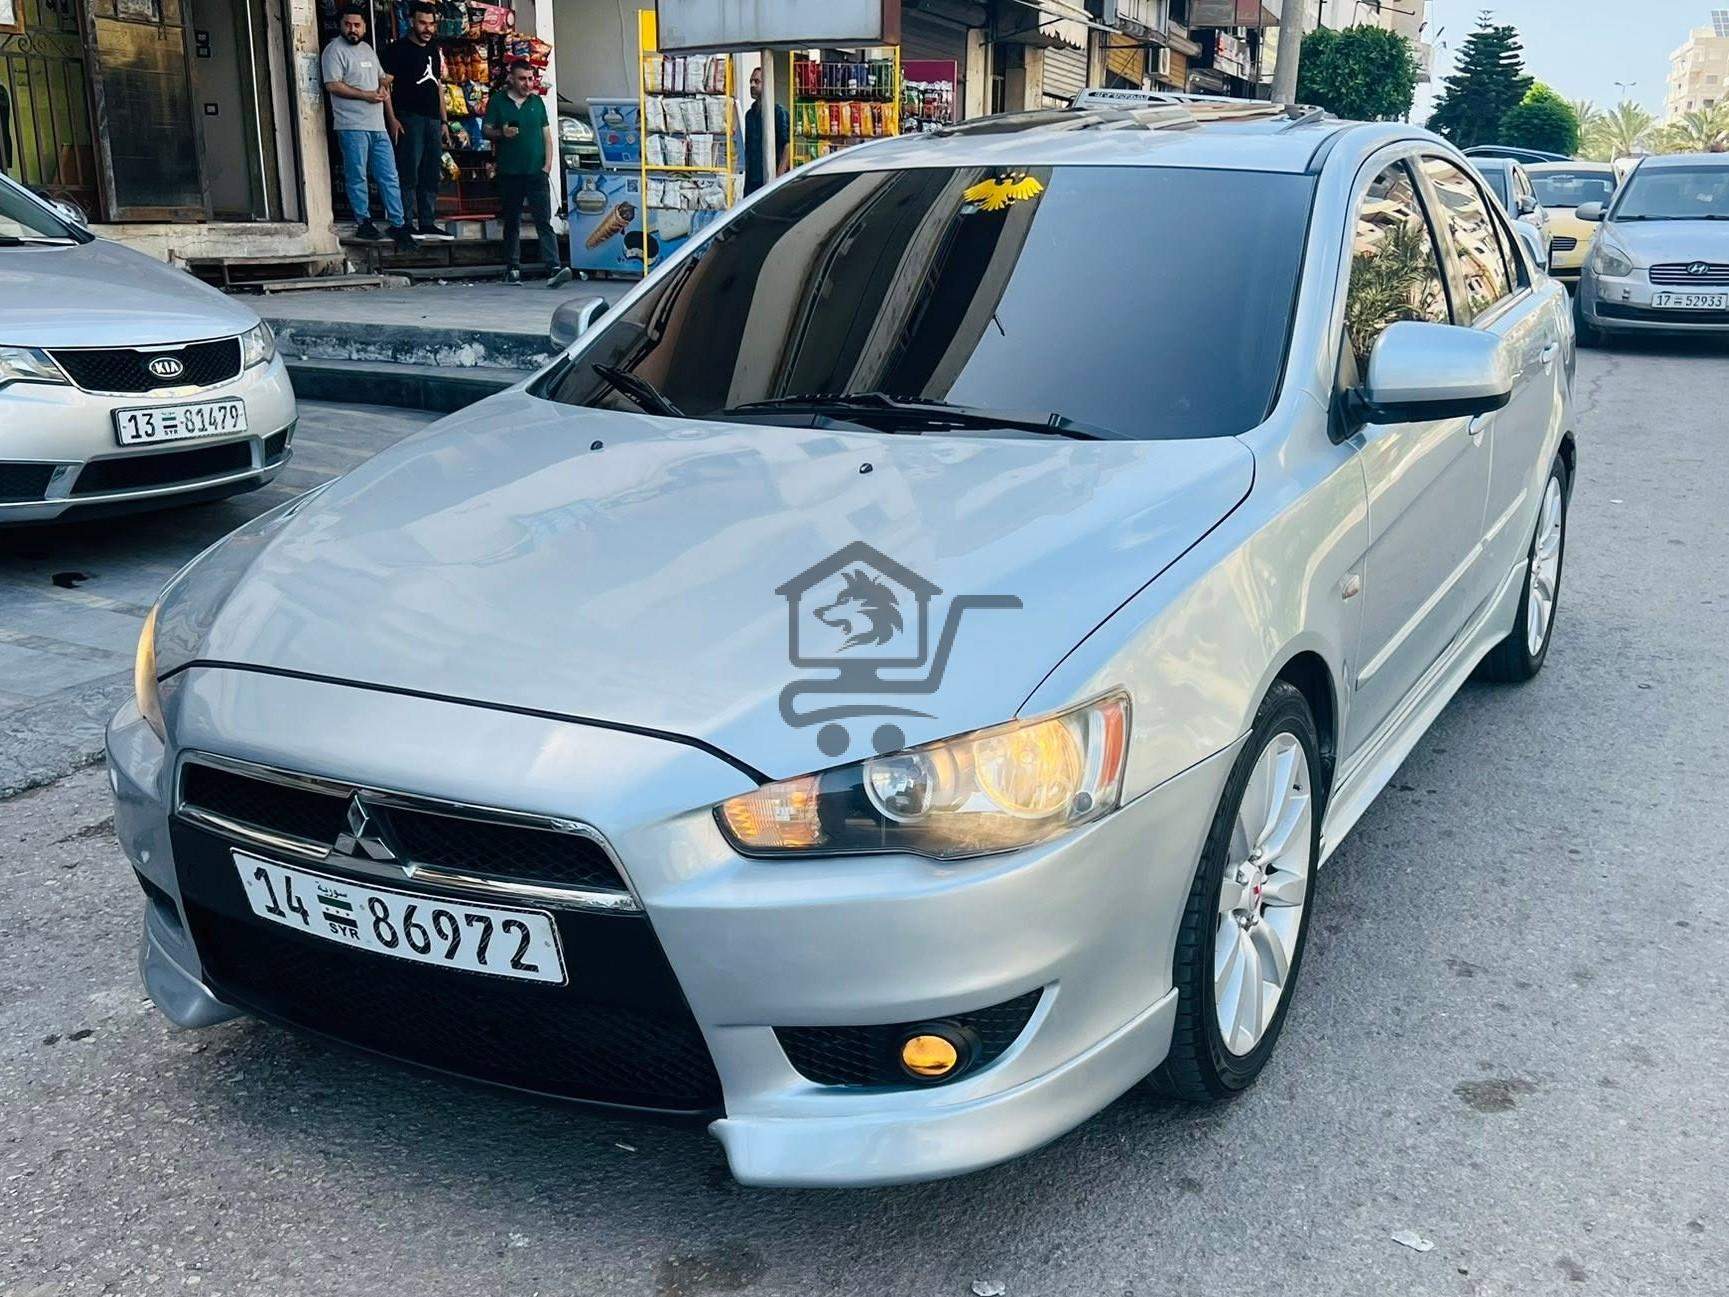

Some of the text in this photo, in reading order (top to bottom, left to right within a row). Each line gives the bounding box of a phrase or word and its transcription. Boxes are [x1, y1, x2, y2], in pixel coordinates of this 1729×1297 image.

[1656, 295, 1722, 307] 17 52933
[154, 361, 179, 374] KIA
[128, 405, 239, 439] 13 81479
[254, 866, 540, 973] 14 86972
[328, 922, 360, 940] SYR
